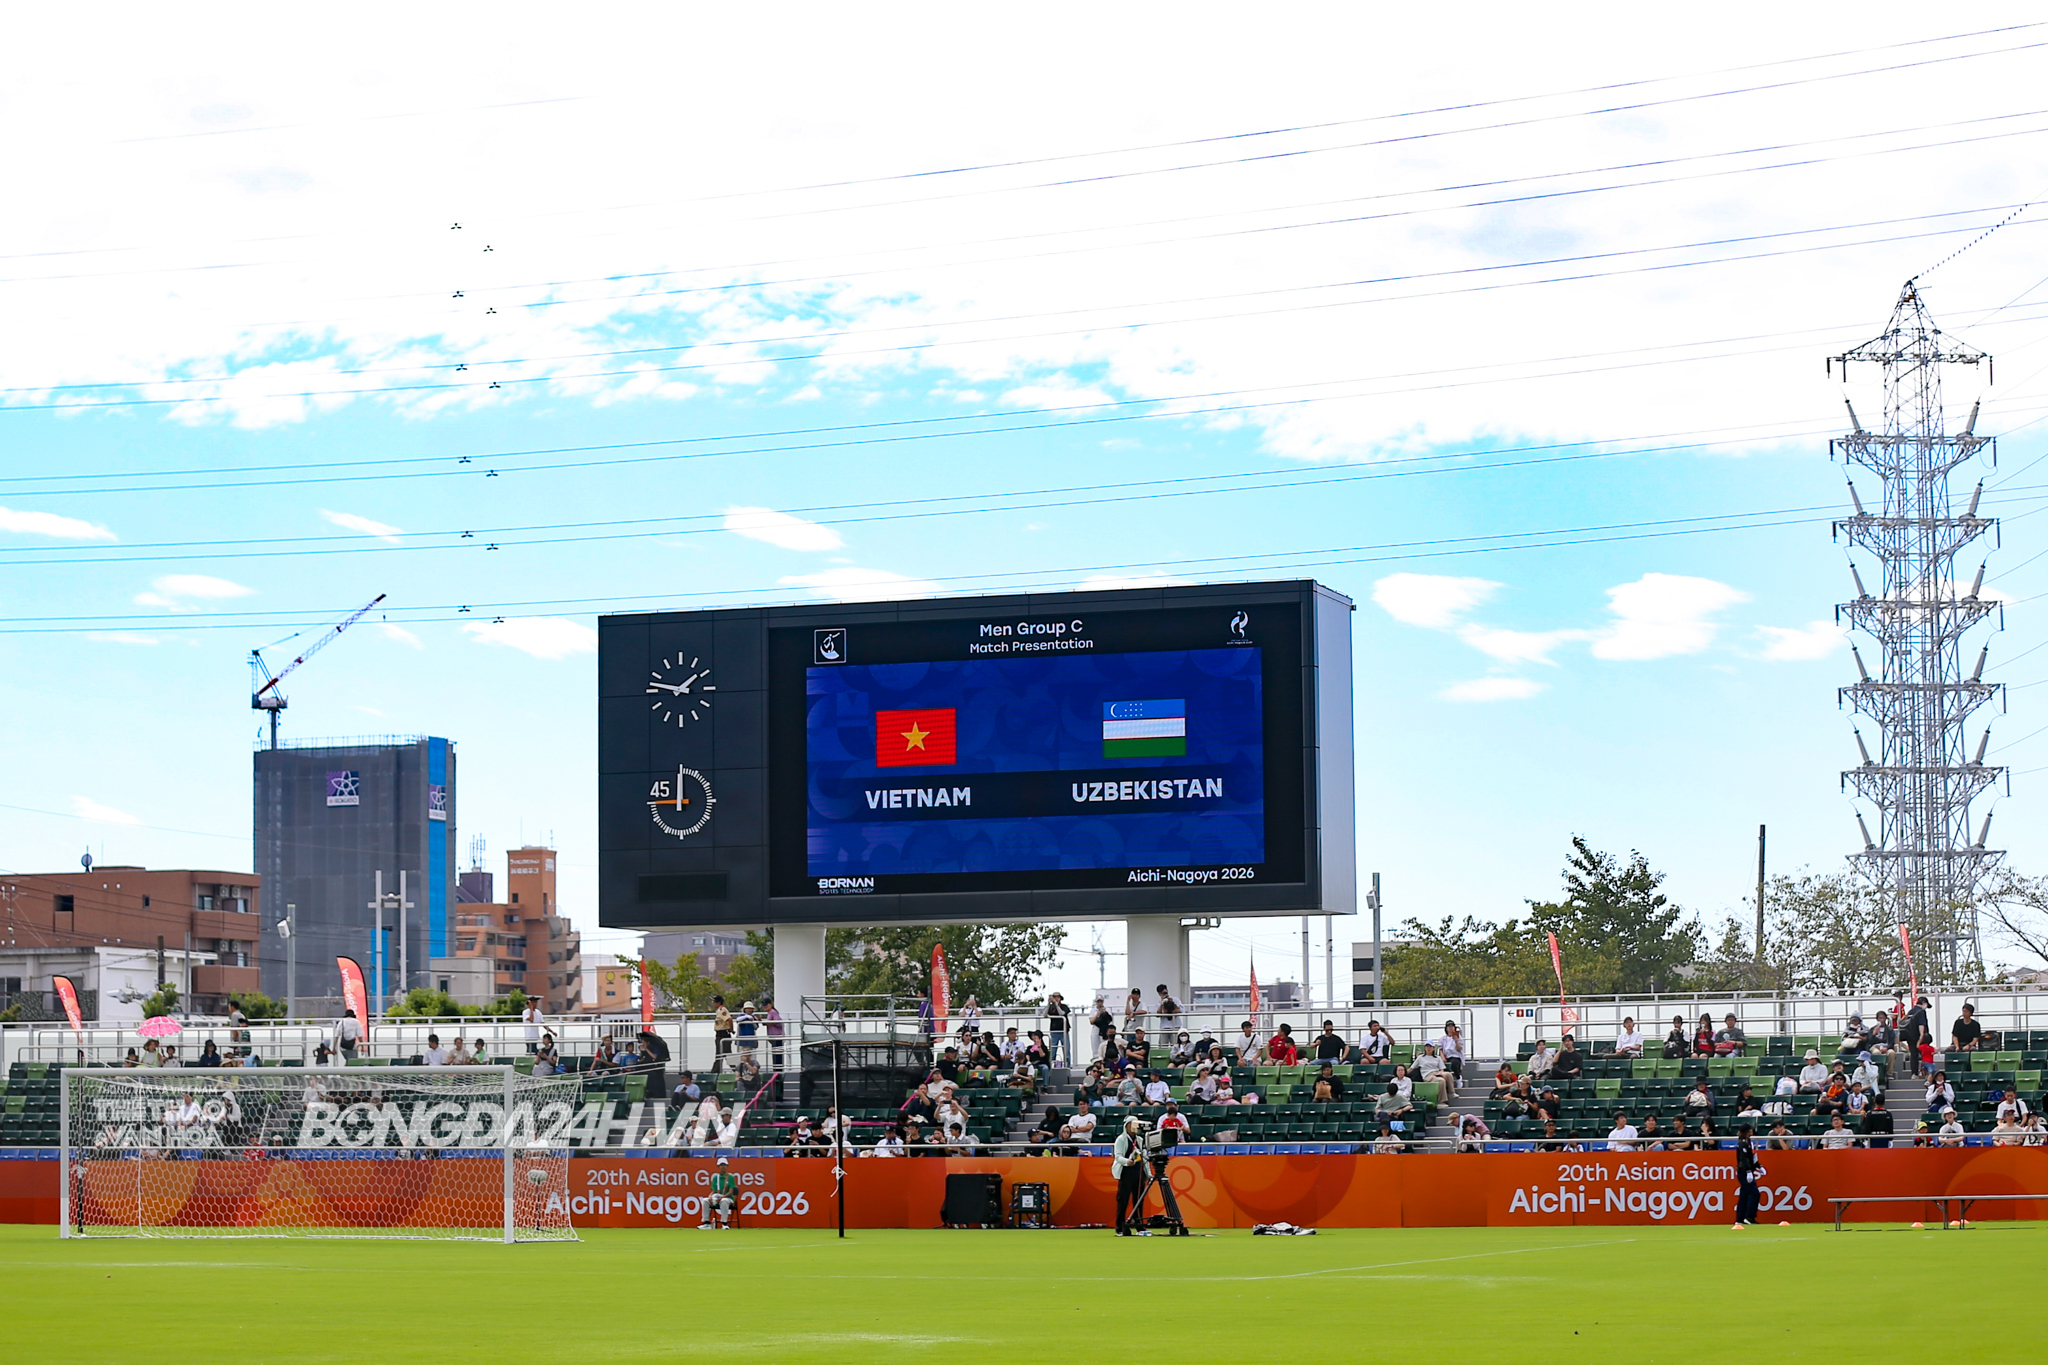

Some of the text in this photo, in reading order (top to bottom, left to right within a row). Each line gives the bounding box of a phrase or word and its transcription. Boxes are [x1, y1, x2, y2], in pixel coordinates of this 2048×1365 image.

[980, 620, 1083, 637] Men Group C
[970, 638, 1094, 653] Match Presentation
[650, 781, 670, 798] 45
[865, 787, 971, 809] VIETNAM
[1072, 778, 1223, 803] UZBEKISTAN
[817, 877, 874, 888] BORNAN
[1127, 867, 1255, 884] Aichi-Nagoya 2026
[587, 1169, 629, 1186] 20th
[636, 1169, 689, 1186] Asian
[1557, 1162, 1762, 1182] 20th Asian Gams
[741, 1191, 810, 1216] 2026
[1509, 1185, 1813, 1220] Aichi-Nagoya 026
